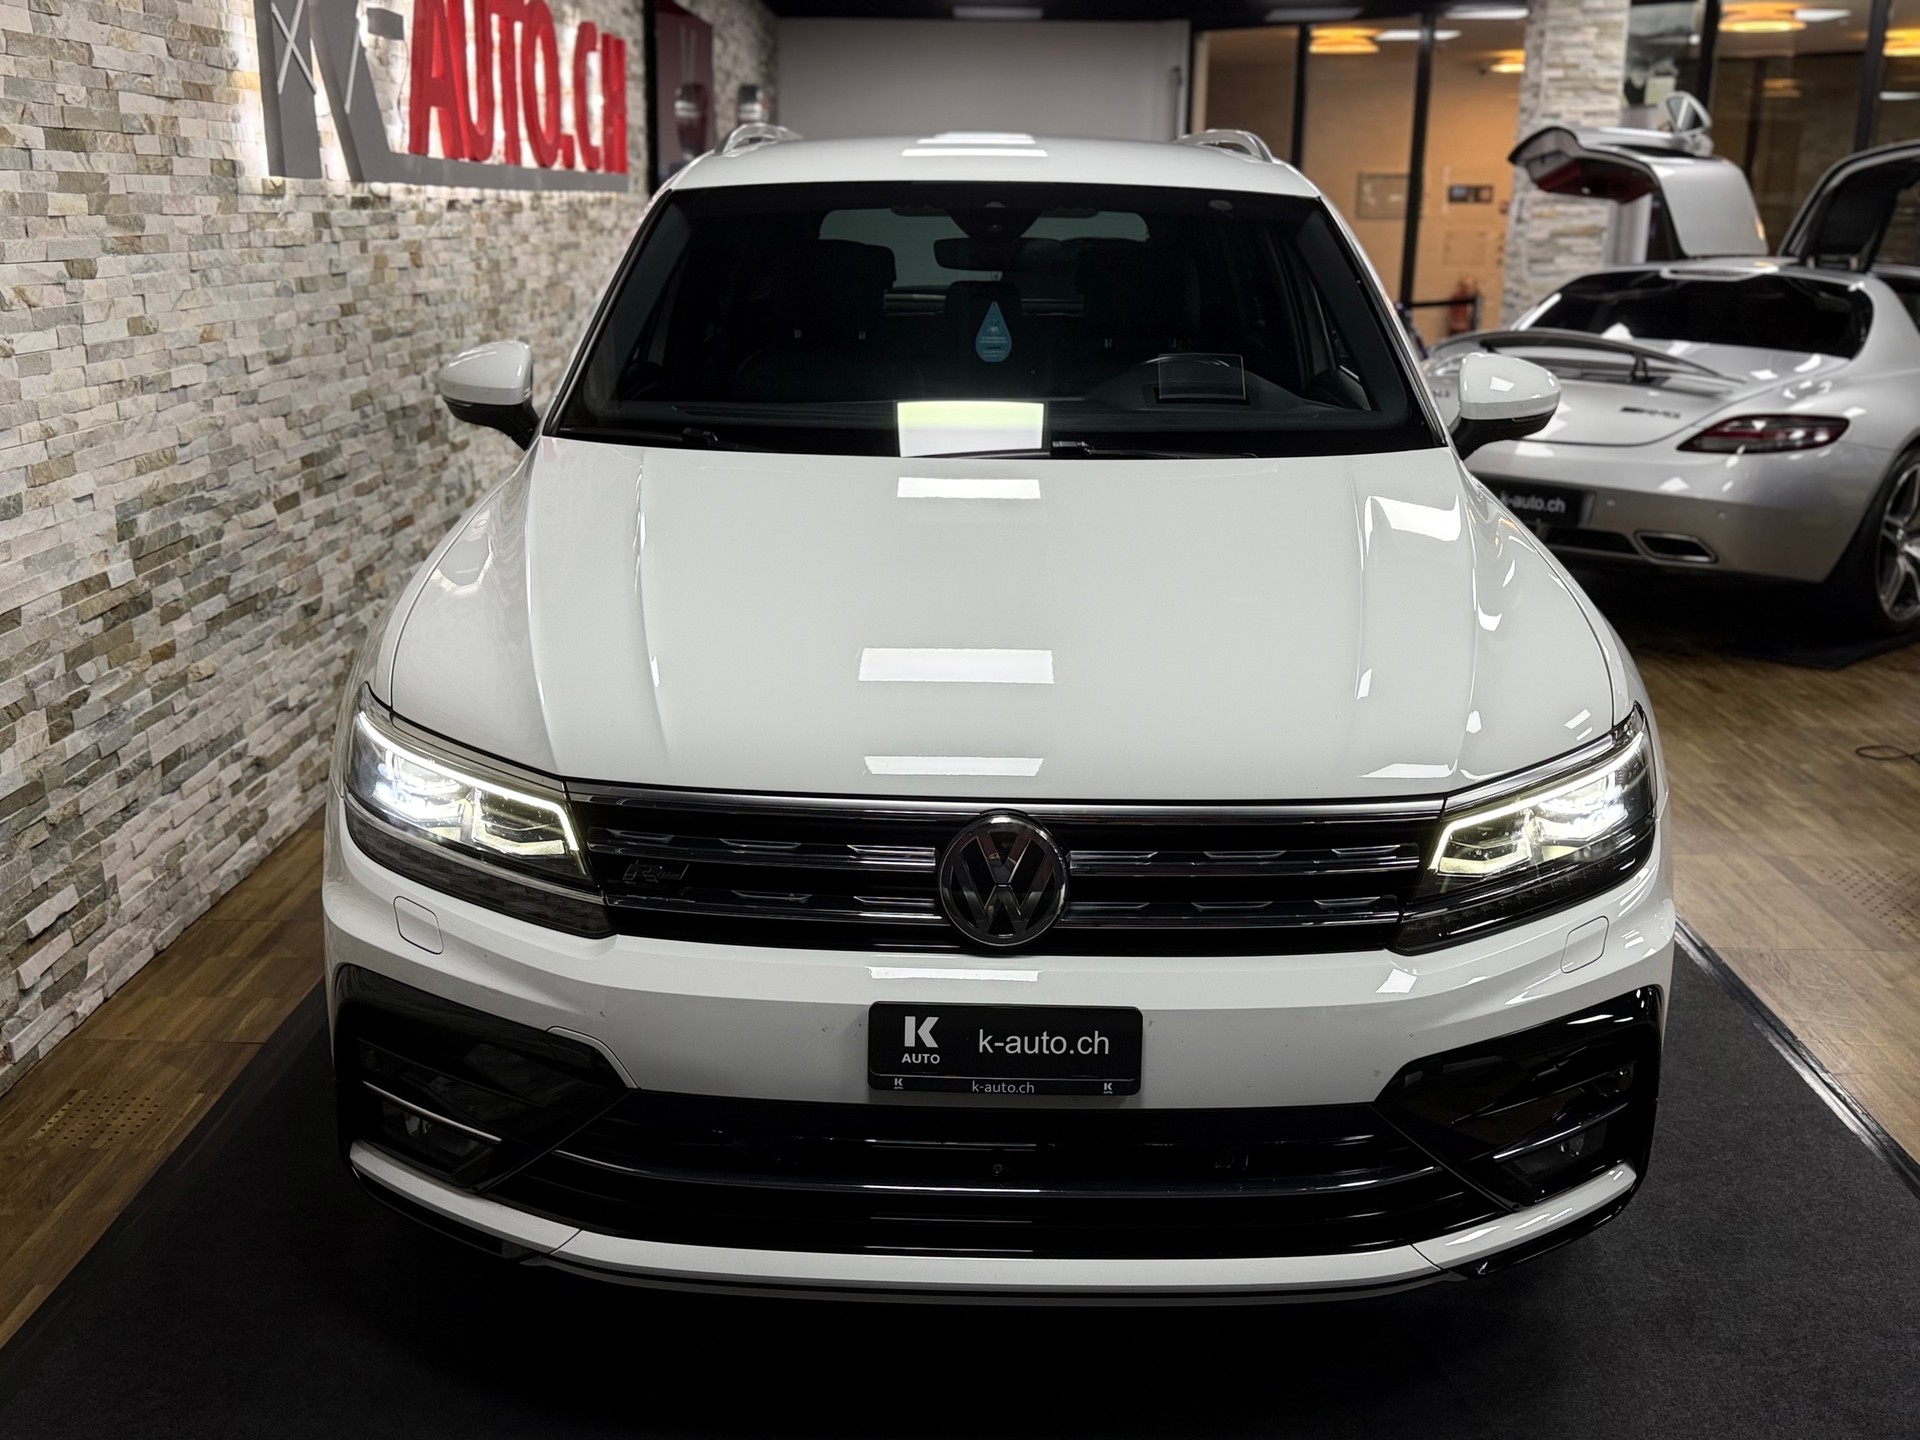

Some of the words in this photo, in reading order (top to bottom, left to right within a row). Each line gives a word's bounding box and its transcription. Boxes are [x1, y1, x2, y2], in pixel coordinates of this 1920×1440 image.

[1501, 491, 1566, 513] k-auto.ch
[904, 1015, 939, 1048] K
[979, 1028, 1110, 1055] k-auto.ch
[901, 1053, 941, 1064] AUTO
[894, 1077, 904, 1087] K
[972, 1080, 1035, 1094] k-auto.ch
[1103, 1082, 1113, 1091] K
